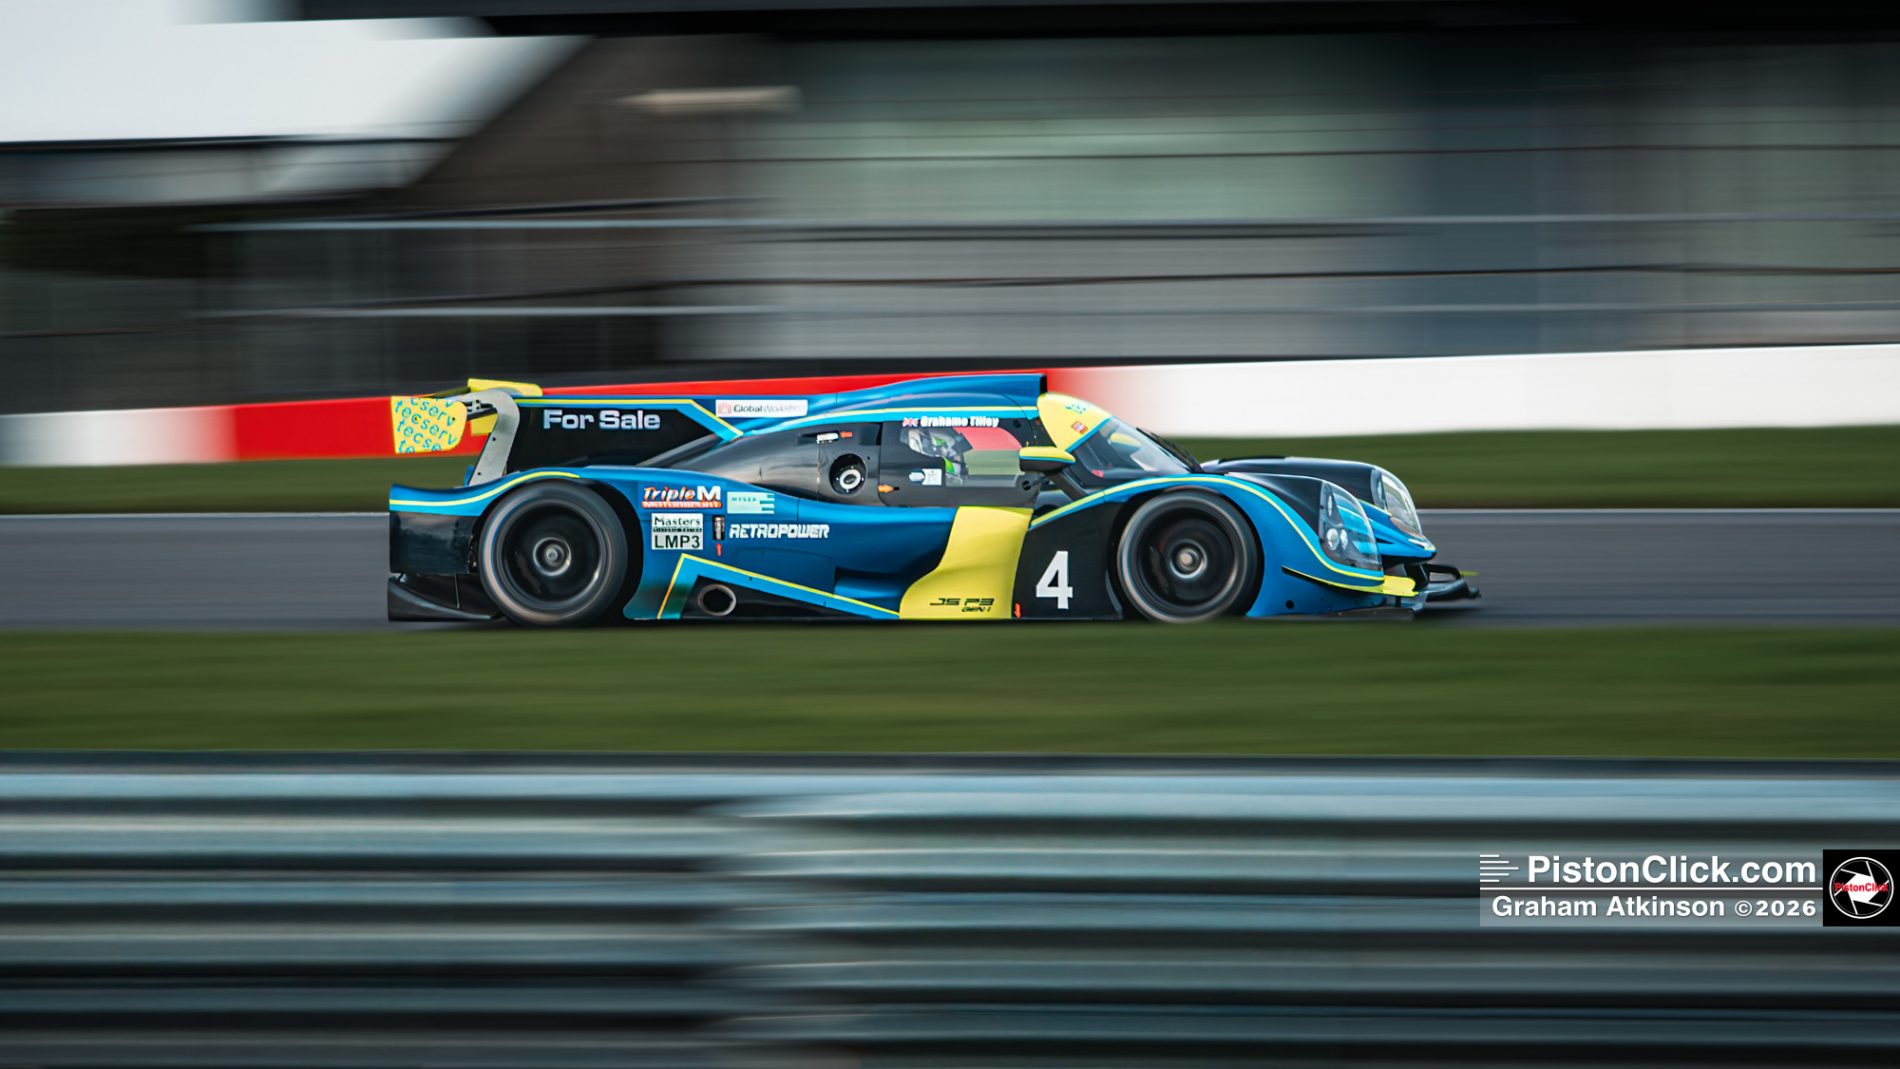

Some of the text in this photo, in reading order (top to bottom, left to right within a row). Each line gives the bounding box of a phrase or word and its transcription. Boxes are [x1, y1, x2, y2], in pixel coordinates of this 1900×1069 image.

[543, 409, 661, 430] For Sale
[654, 516, 701, 526] Masters
[729, 523, 830, 539] RETROPOWER
[654, 534, 701, 549] LMP3
[1035, 550, 1074, 610] 4
